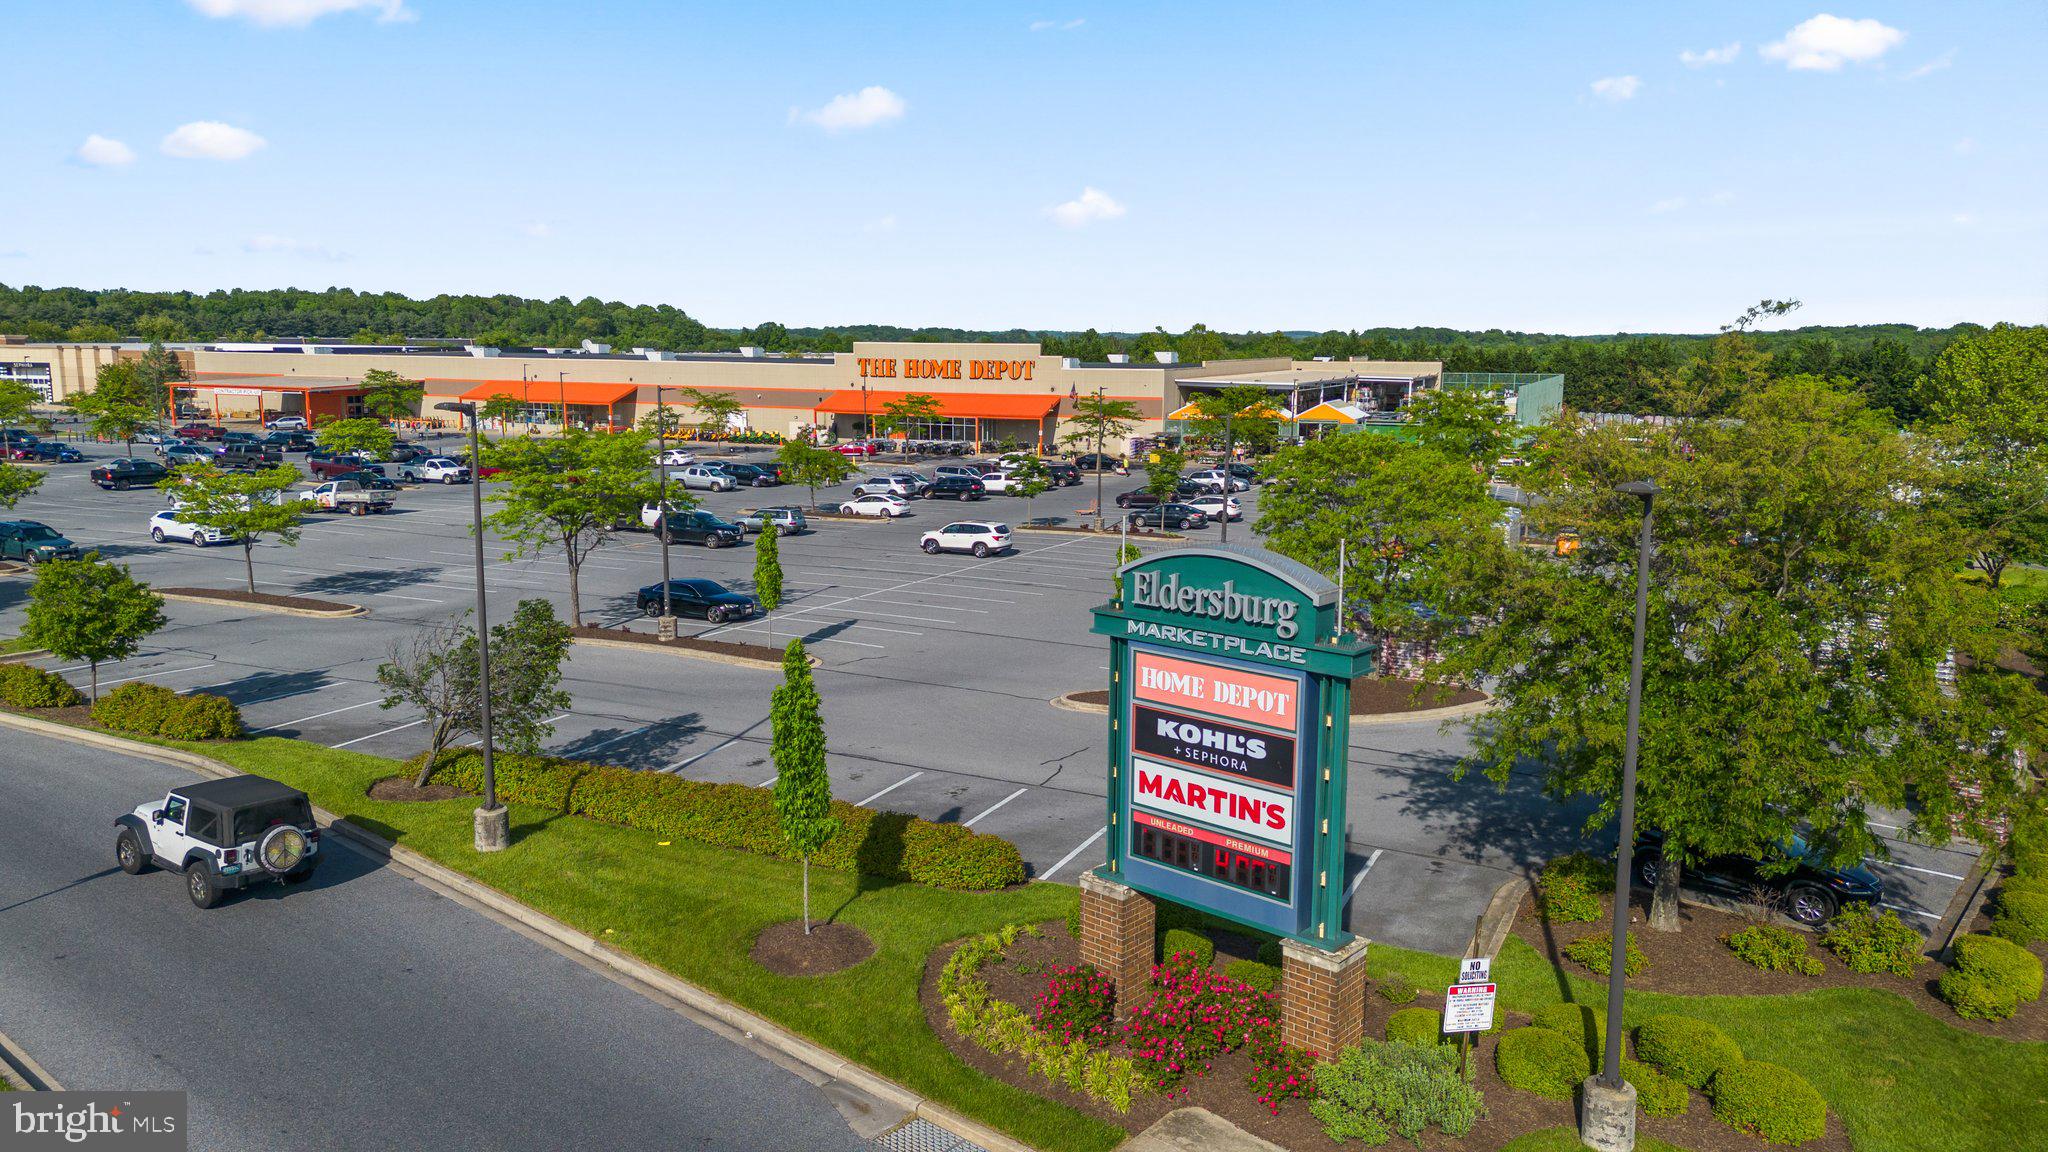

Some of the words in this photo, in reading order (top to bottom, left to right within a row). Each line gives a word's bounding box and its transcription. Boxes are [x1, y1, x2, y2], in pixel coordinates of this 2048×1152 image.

[857, 358, 897, 378] THE
[903, 359, 962, 379] HOME
[969, 360, 1036, 380] DEPOT
[1132, 570, 1299, 639] Eldersburg
[1127, 620, 1307, 664] MARKETPLACE
[1141, 666, 1205, 699] HOME
[1213, 680, 1290, 716] DEPOT
[1157, 718, 1267, 759] KOHL'S
[1185, 747, 1248, 772] SEPHORA
[1138, 770, 1286, 830] MARTIN'S
[1150, 818, 1194, 836] UNLEADED
[1225, 839, 1269, 858] PREMIUM
[1461, 970, 1487, 980] SOLICITING
[1470, 961, 1481, 970] NO
